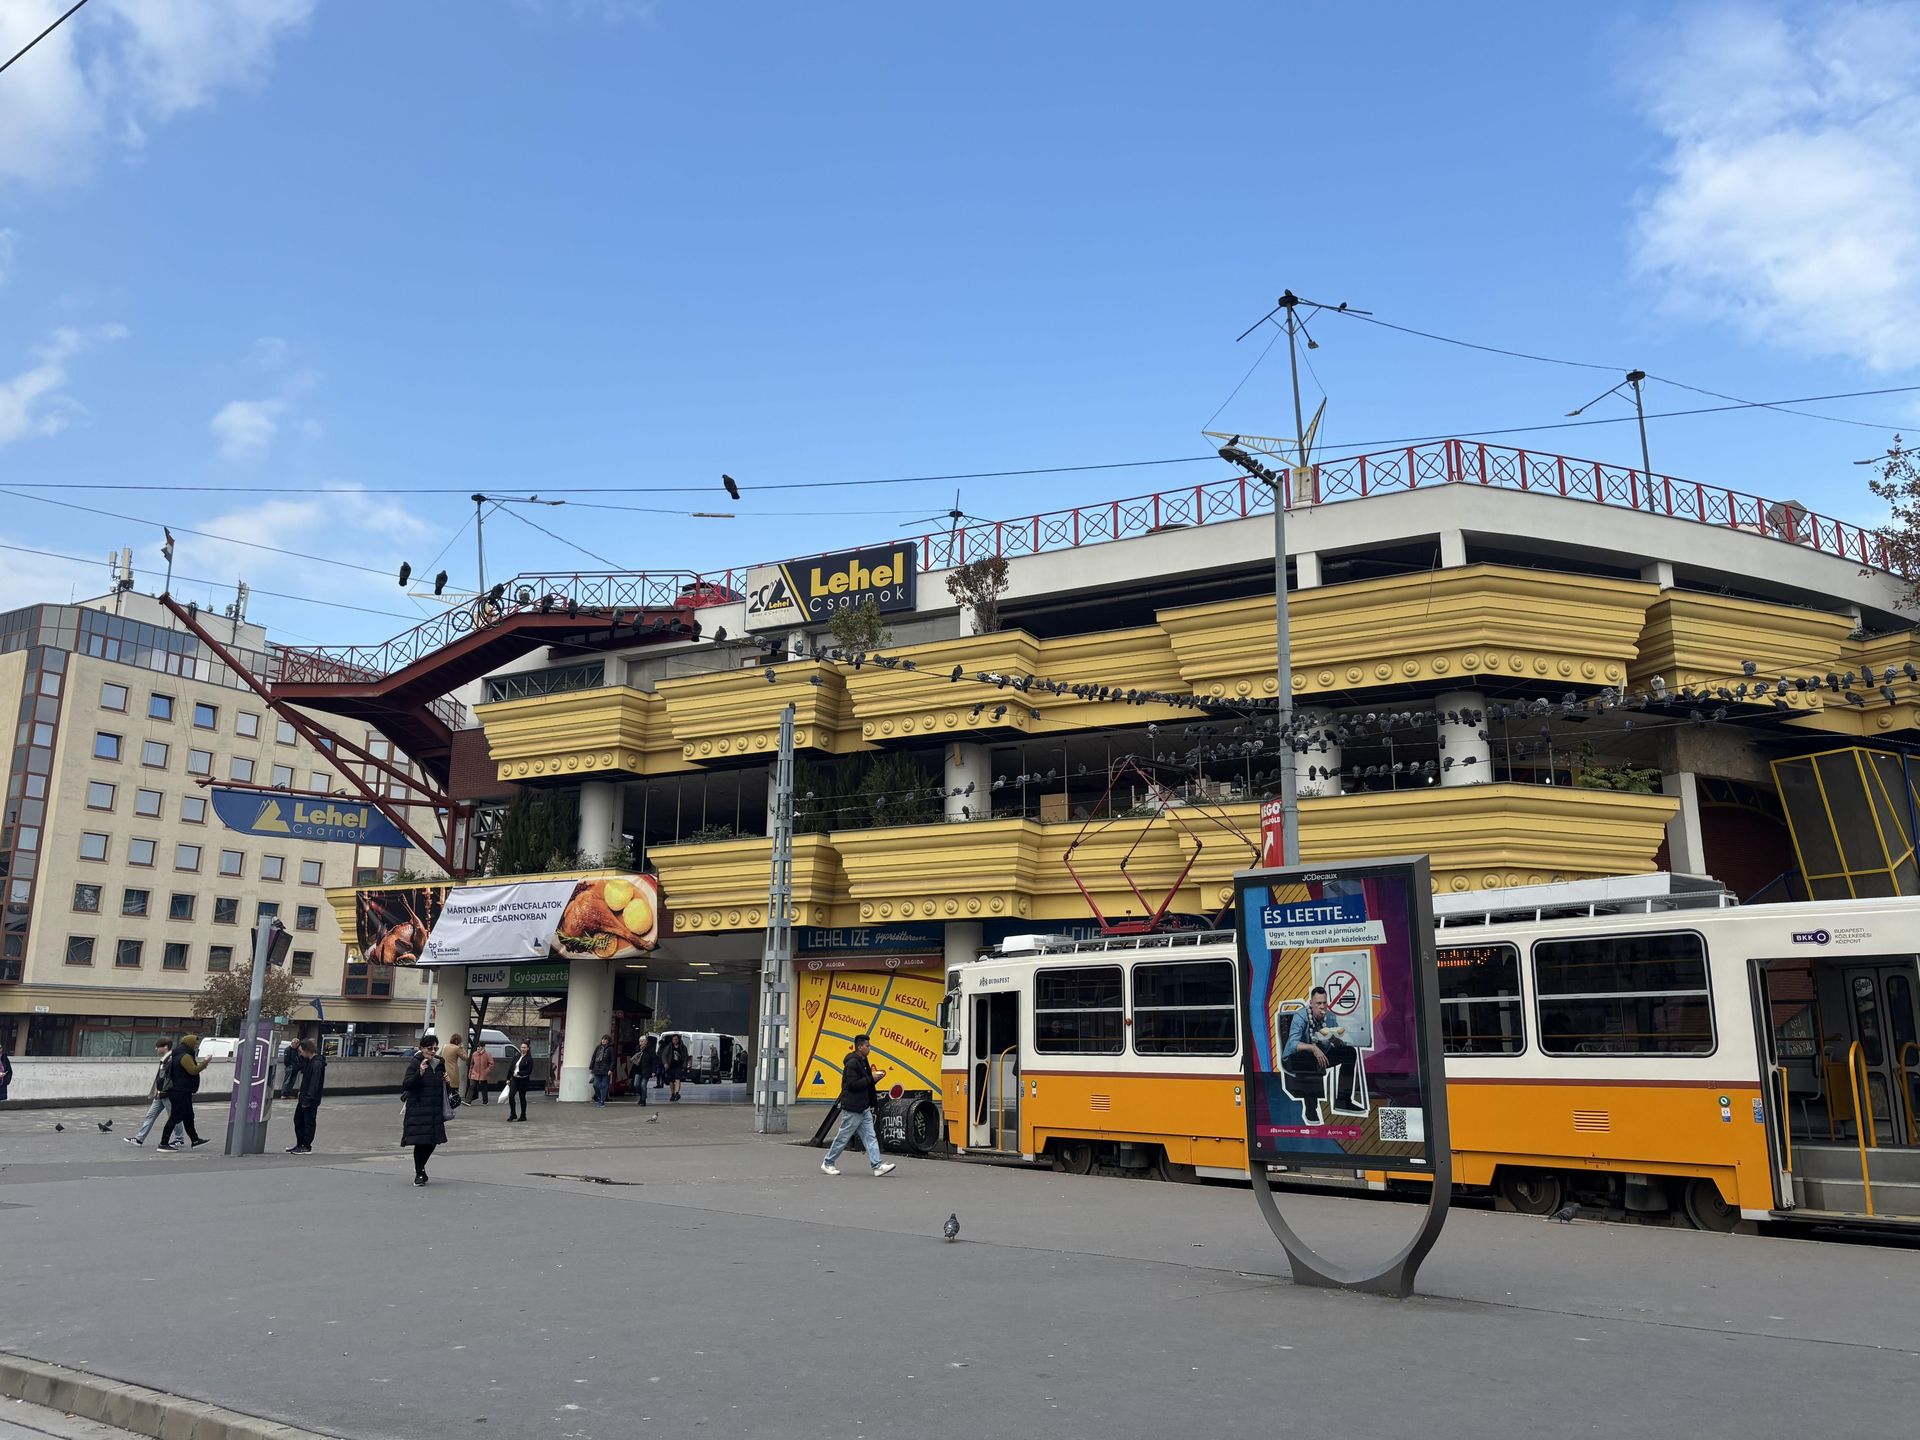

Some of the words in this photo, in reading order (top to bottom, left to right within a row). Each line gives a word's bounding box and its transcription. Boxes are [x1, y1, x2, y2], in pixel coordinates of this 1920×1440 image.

[810, 552, 904, 597] Lehel
[768, 598, 790, 609] Lehel
[809, 585, 904, 613] Csarnok
[293, 803, 368, 828] Lehel
[293, 824, 365, 839] Csarnok
[1301, 873, 1338, 882] JCDecaux
[446, 904, 498, 915] MÁRTON-NAPI
[1263, 907, 1282, 924] ÉS
[1287, 906, 1360, 923] LEETTE...
[462, 917, 468, 925] A
[469, 915, 491, 925] LEHEL
[491, 913, 547, 924] CSARNOKBAN
[808, 929, 848, 948] LEHEL
[1311, 928, 1328, 936] eszel
[1796, 934, 1814, 942] BKK
[1269, 939, 1289, 947] Köszi,
[1289, 937, 1305, 946] hogy
[1306, 936, 1340, 945] kulturáltan
[1341, 934, 1380, 943] közlekedsz!
[472, 973, 496, 983] BENU
[513, 970, 569, 984] Gyógyszertá
[811, 976, 825, 986] ITT
[835, 980, 868, 995] VALAMI
[869, 986, 881, 997] ÚJ
[895, 993, 930, 1012] KÉSZÜL,
[828, 1011, 868, 1030] KÖSZÖNJÜK
[879, 1026, 938, 1062] TÜRELMÜKET!
